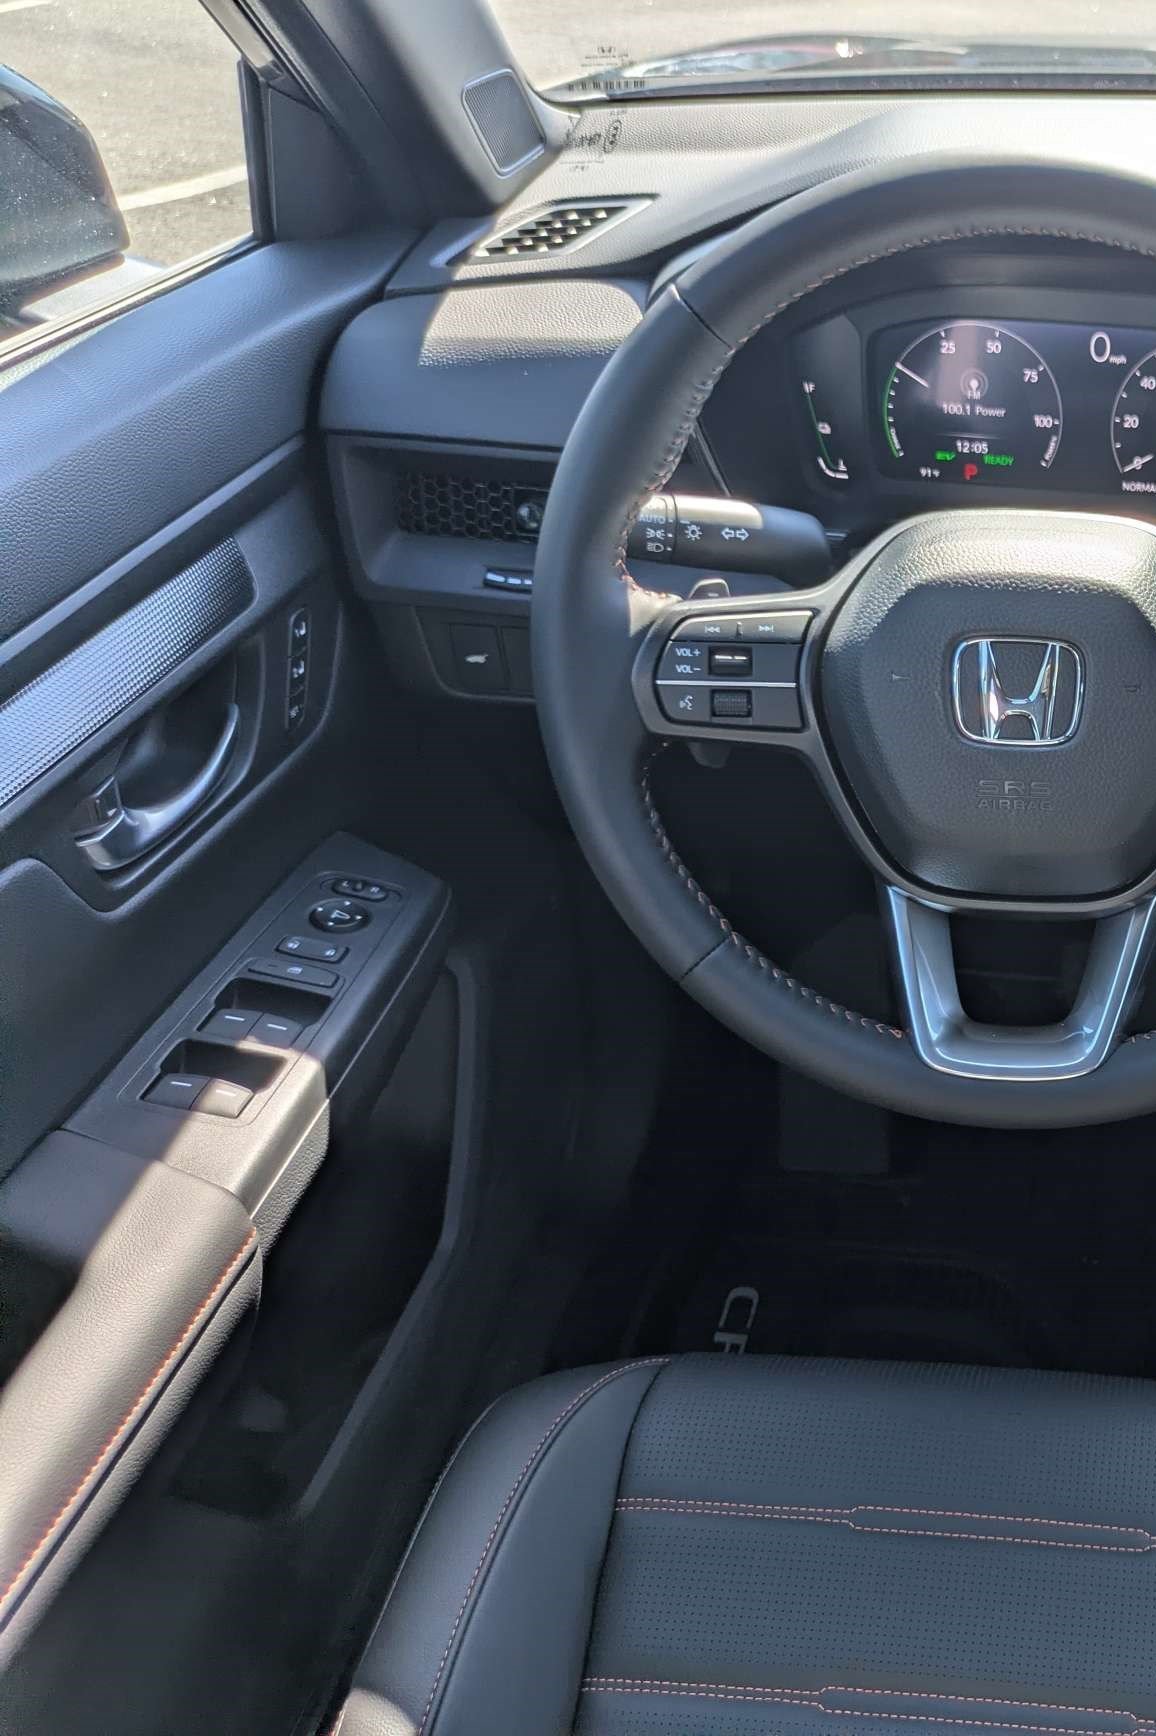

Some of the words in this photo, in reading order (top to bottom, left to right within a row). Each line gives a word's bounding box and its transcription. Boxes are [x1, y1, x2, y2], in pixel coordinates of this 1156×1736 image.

[940, 341, 956, 354] 25
[986, 341, 1002, 354] 50
[1089, 331, 1111, 363] 0
[1109, 355, 1127, 366] mph
[1023, 369, 1039, 383] 75
[1140, 376, 1156, 390] 40
[941, 403, 971, 416] 100.1
[975, 405, 1006, 417] Power
[1034, 415, 1053, 428] 100
[1123, 415, 1139, 428] 20
[955, 440, 989, 453] 12:05
[983, 455, 1014, 467] READY
[963, 464, 978, 480] P
[639, 514, 665, 525] AUTO
